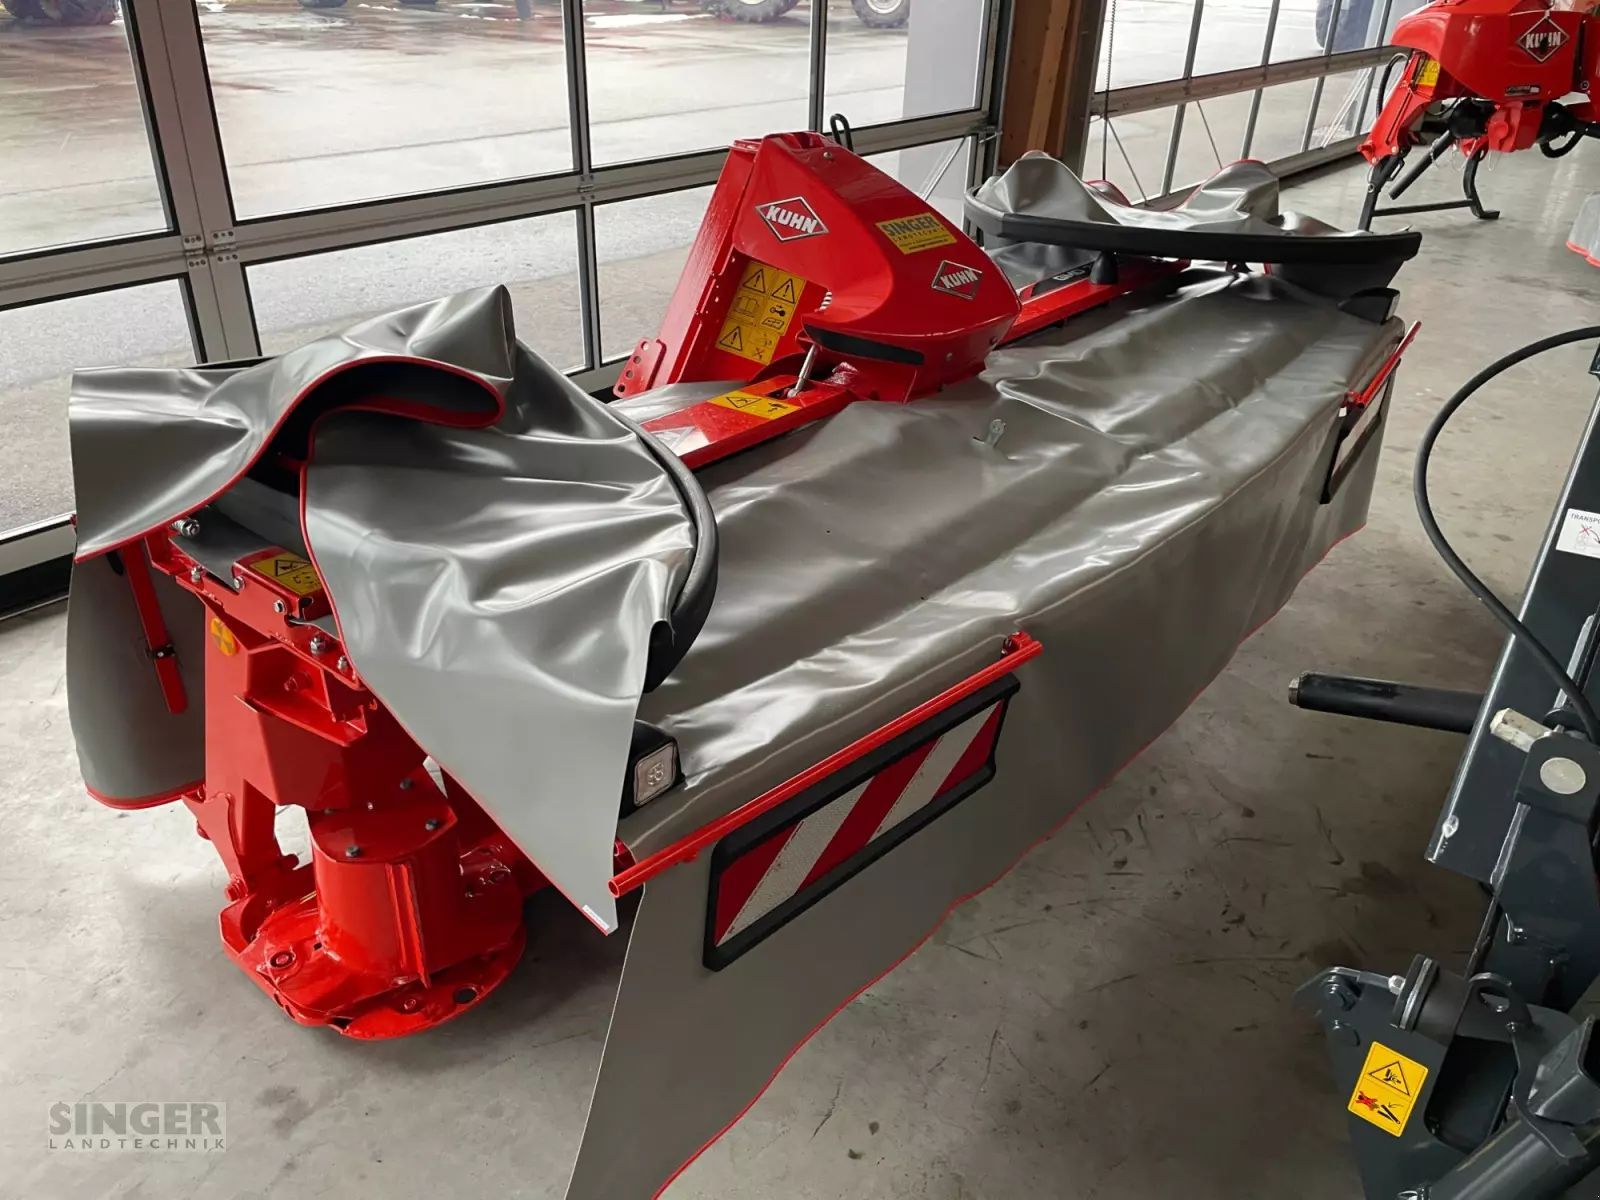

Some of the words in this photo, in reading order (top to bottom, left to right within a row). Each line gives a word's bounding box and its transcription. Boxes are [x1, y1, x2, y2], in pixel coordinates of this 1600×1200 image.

[765, 205, 818, 234] KUHN
[881, 215, 941, 237] SINGER
[940, 268, 979, 289] KUHN
